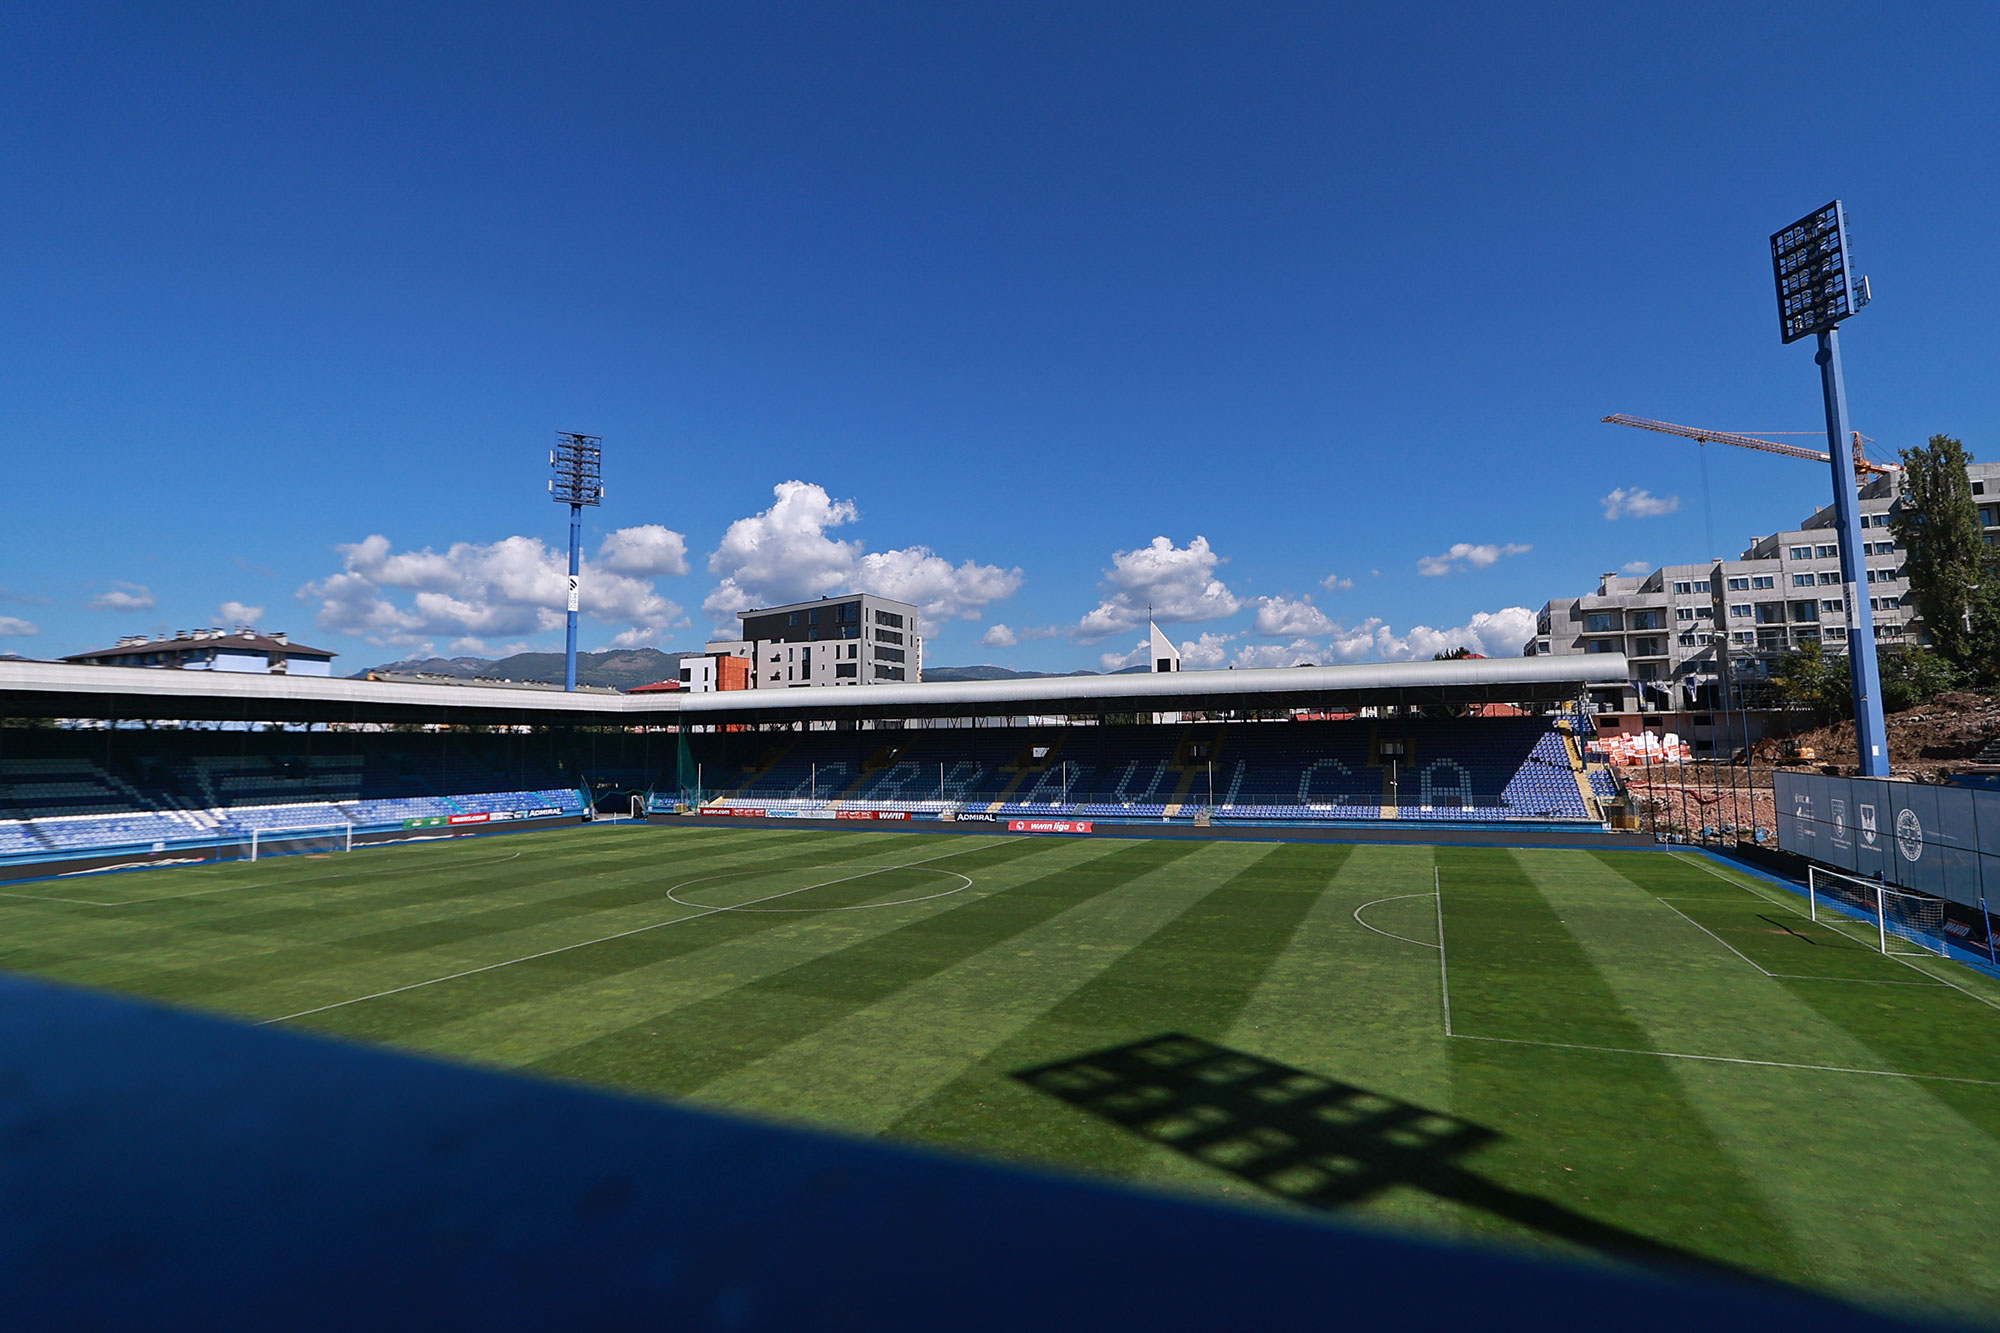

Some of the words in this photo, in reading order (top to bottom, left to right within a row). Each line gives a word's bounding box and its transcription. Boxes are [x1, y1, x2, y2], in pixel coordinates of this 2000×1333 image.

[528, 808, 562, 817] ADMIRAL
[956, 813, 996, 822] ADMIRAL
[1053, 821, 1070, 832] liga
